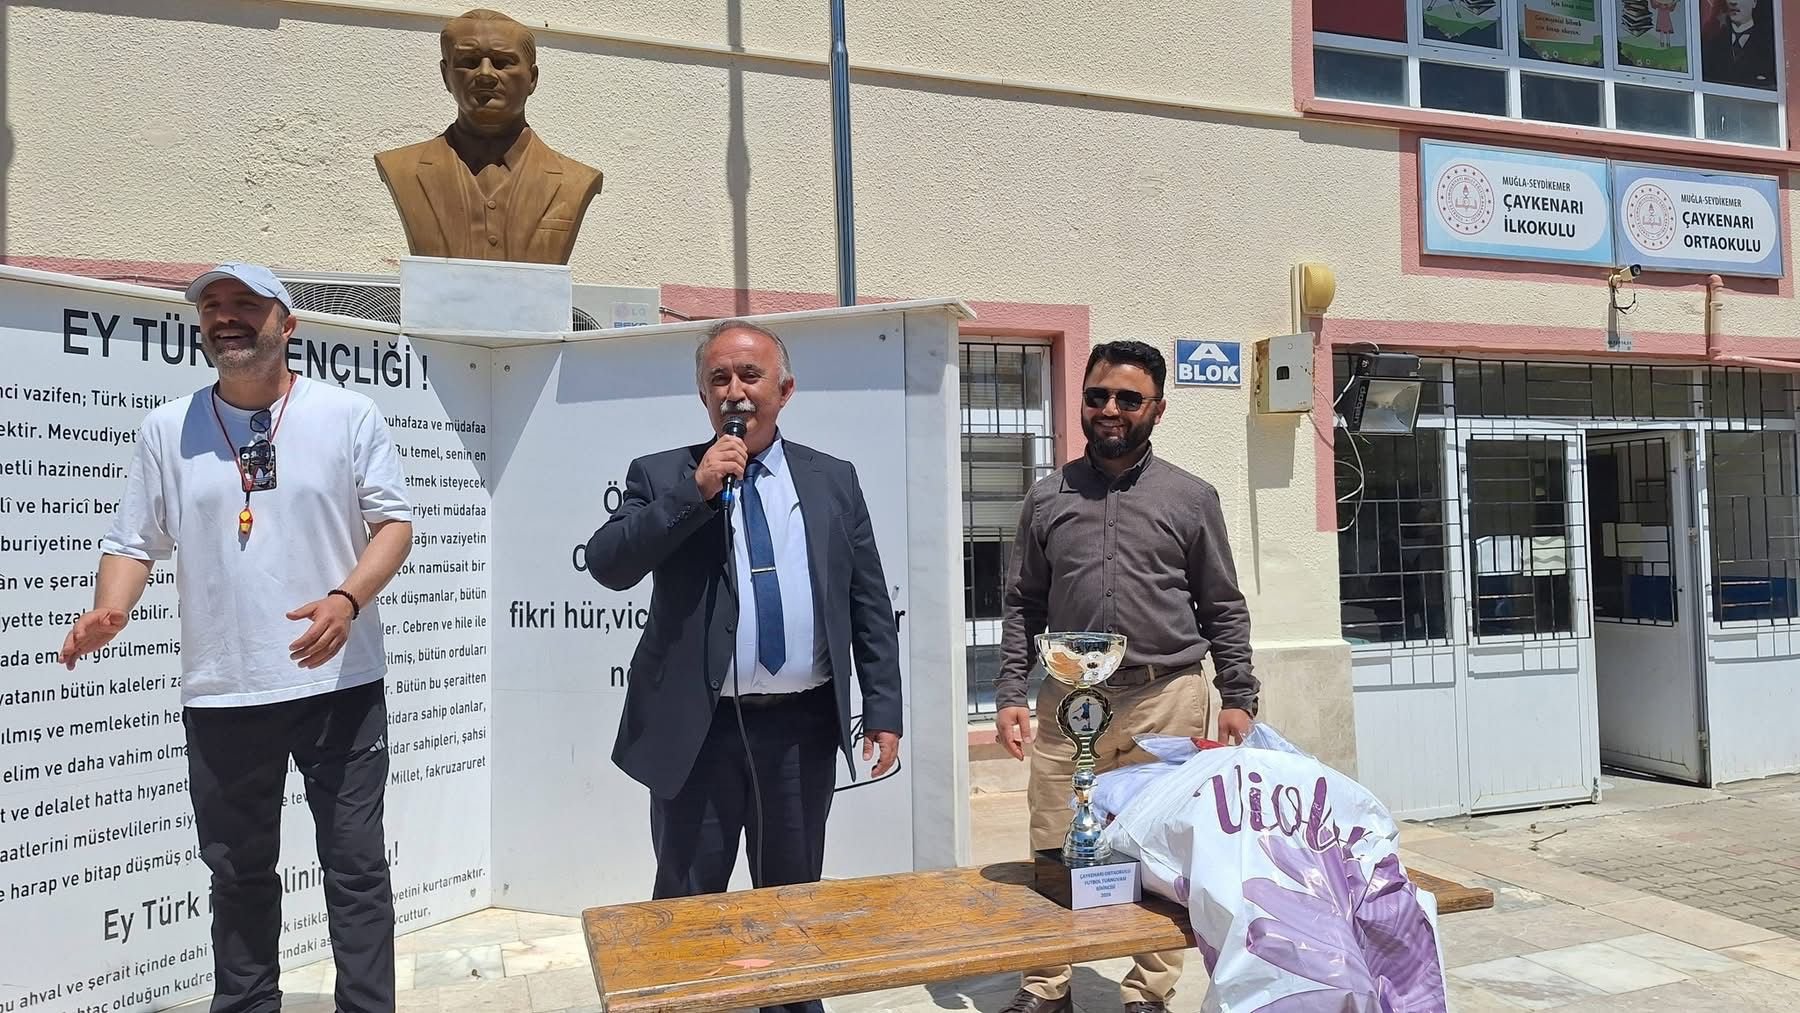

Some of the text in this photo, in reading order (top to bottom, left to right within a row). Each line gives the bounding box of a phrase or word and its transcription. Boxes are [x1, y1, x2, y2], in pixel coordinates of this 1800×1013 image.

[1502, 175, 1571, 192] MUĞLA-SEYDİKEMER
[1503, 193, 1584, 215] ÇAYKENARI
[1681, 193, 1742, 208] MUĞLA-SEYDİKEMER
[1504, 215, 1576, 238] İLKOKULU
[1682, 211, 1754, 230] ÇAYKENARI
[1684, 234, 1761, 252] ORTAOKULU
[63, 308, 120, 358] EY
[133, 312, 216, 368] TÜR
[287, 338, 411, 389] ENÇLİĞİ
[1187, 342, 1231, 364] A
[1178, 363, 1239, 382] BLOK
[23, 387, 87, 407] vazifen;
[91, 390, 127, 408] Türk
[0, 421, 141, 446] ektir. Mevcudiyet
[384, 415, 486, 434] uhafaza ve müdafaa
[410, 445, 443, 461] temel,
[445, 447, 472, 461] senin
[474, 450, 486, 461] en
[38, 460, 128, 478] hazinendir.
[440, 475, 486, 490] isteyecek
[16, 502, 36, 514] ve
[412, 503, 486, 519] riyeti müdafaa
[0, 535, 92, 555] buriyetine
[440, 532, 486, 547] vaziyetin
[419, 561, 469, 574] namüsait
[471, 560, 486, 572] bir
[24, 577, 44, 589] ve
[375, 587, 486, 605] ecek düşmanlar, bütün
[2, 613, 43, 632] yette
[128, 604, 173, 621] ebilir.
[510, 600, 555, 628] fikri
[382, 615, 486, 636] ler. Cebren ve hile ile
[0, 650, 29, 667] ada
[387, 644, 487, 665] ilmiş, bütün orduları
[61, 682, 105, 699] bütün
[109, 675, 165, 694] kaleleri
[396, 680, 427, 694] Bütün
[429, 677, 441, 690] bu
[444, 673, 487, 690] şeraitten
[388, 700, 487, 725] tidara sahip olanlar,
[1, 727, 42, 745] ılmış
[46, 725, 65, 738] ve
[70, 712, 159, 736] memleketin
[413, 731, 460, 751] sahipleri,
[462, 727, 486, 743] şahsi
[3, 766, 40, 783] elim
[45, 763, 62, 777] ve
[67, 756, 104, 773] daha
[109, 748, 153, 767] vahim
[391, 755, 486, 785] Millet, fakruzaruret
[11, 808, 29, 821] ve
[34, 794, 90, 818] delalet
[95, 789, 133, 807] hatta
[138, 778, 188, 801] hıyanet
[0, 834, 69, 863] aatlerini
[73, 816, 171, 848] müstevlilerin
[10, 878, 57, 900] harap
[62, 873, 79, 887] ve
[84, 864, 121, 883] bitap
[125, 851, 181, 874] düşmüş
[393, 886, 421, 904] yetini
[423, 867, 486, 892] kurtarmaktır.
[104, 908, 135, 944] Ey
[142, 891, 201, 930] Türk
[19, 983, 62, 1008] ahval
[66, 981, 84, 994] ve
[88, 965, 130, 990] şerait
[135, 953, 176, 975] içinde
[180, 943, 208, 962] dahi
[113, 987, 171, 1010] olduğun
